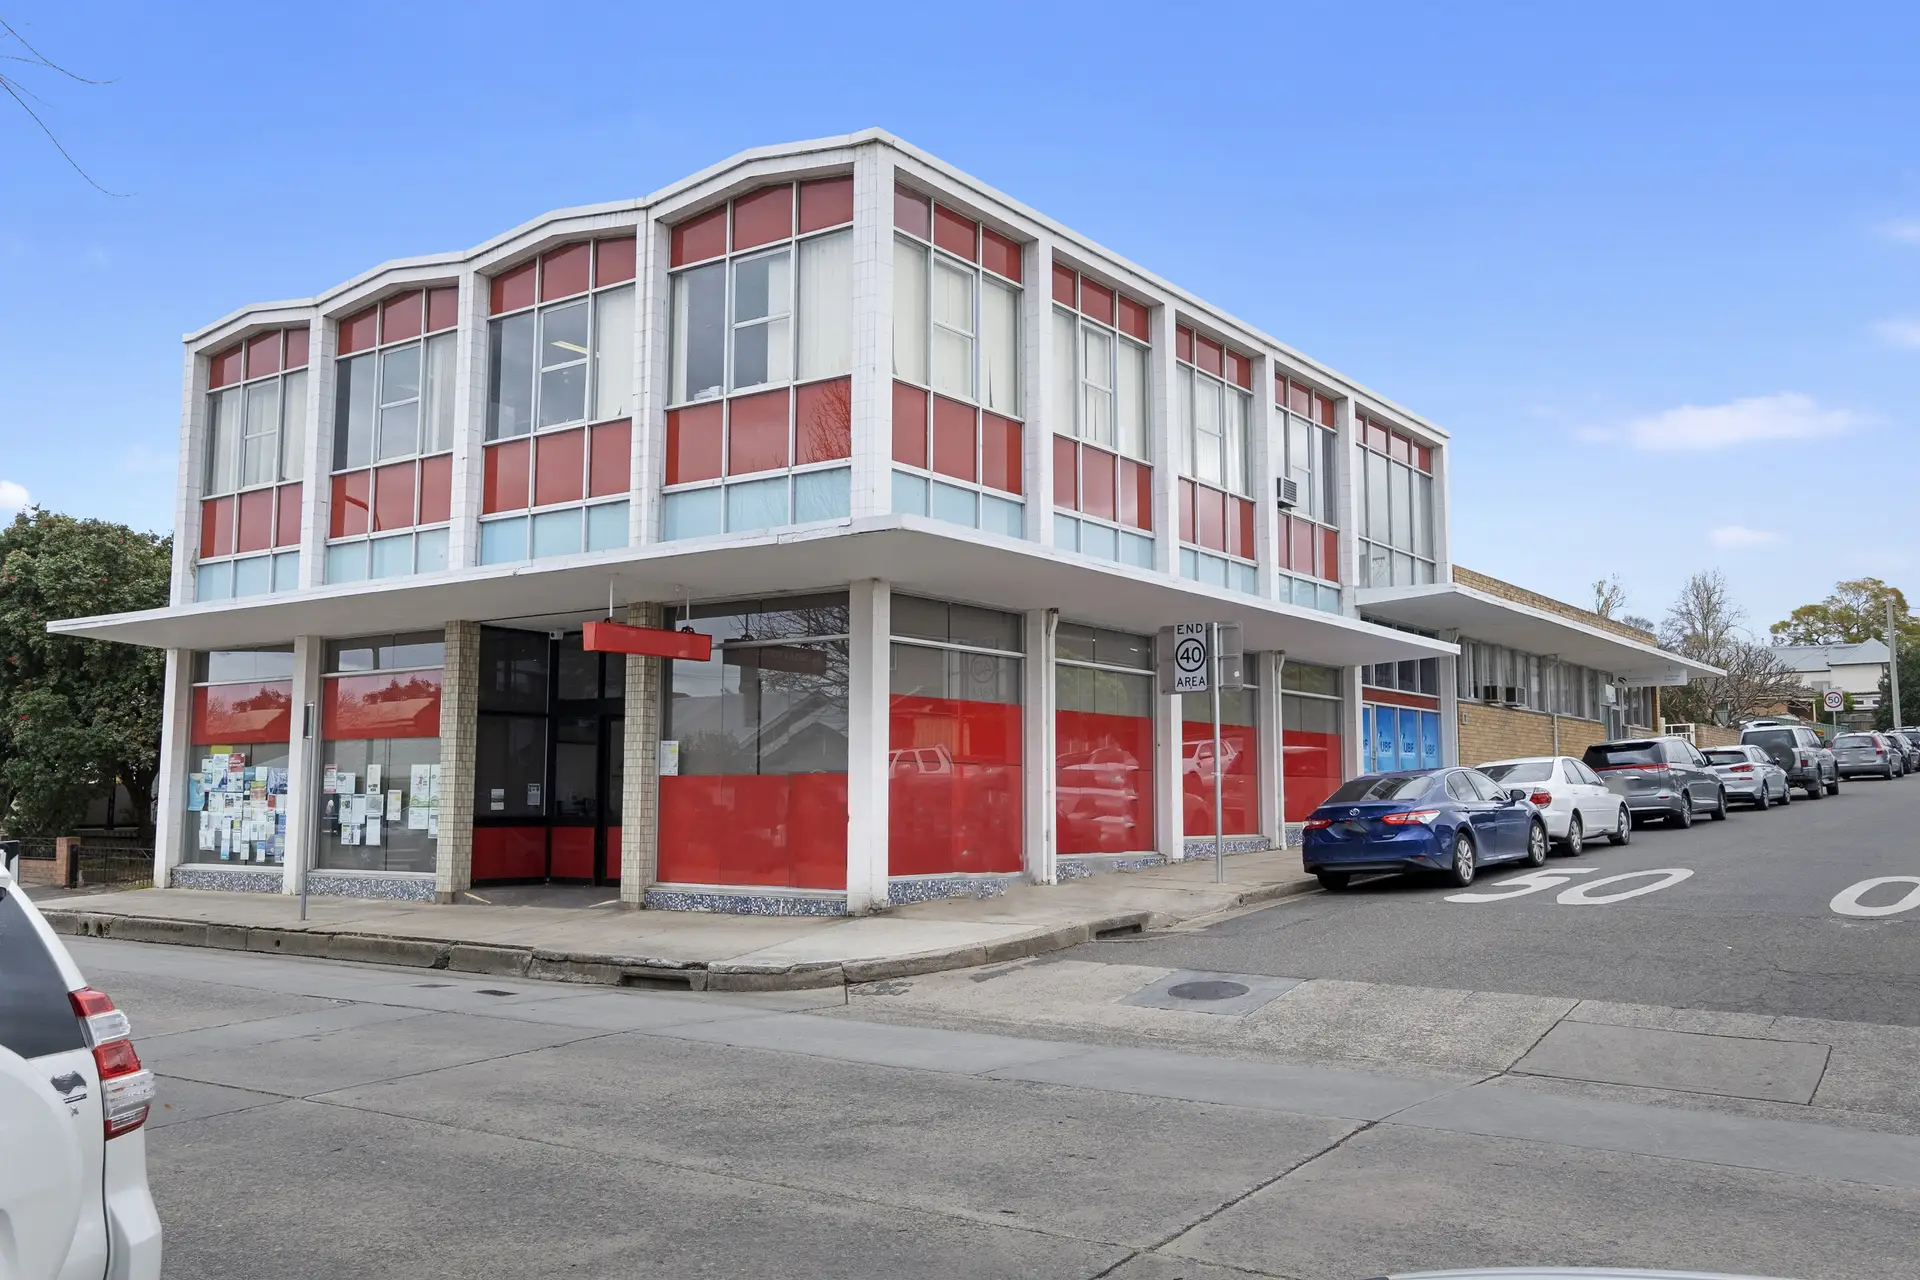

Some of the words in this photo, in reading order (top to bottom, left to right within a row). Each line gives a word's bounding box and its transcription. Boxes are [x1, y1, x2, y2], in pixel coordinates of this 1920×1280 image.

[1177, 623, 1203, 634] END
[1180, 646, 1202, 663] 40
[1176, 676, 1206, 687] AREA
[1828, 696, 1840, 704] 50
[1444, 868, 1695, 905] 50
